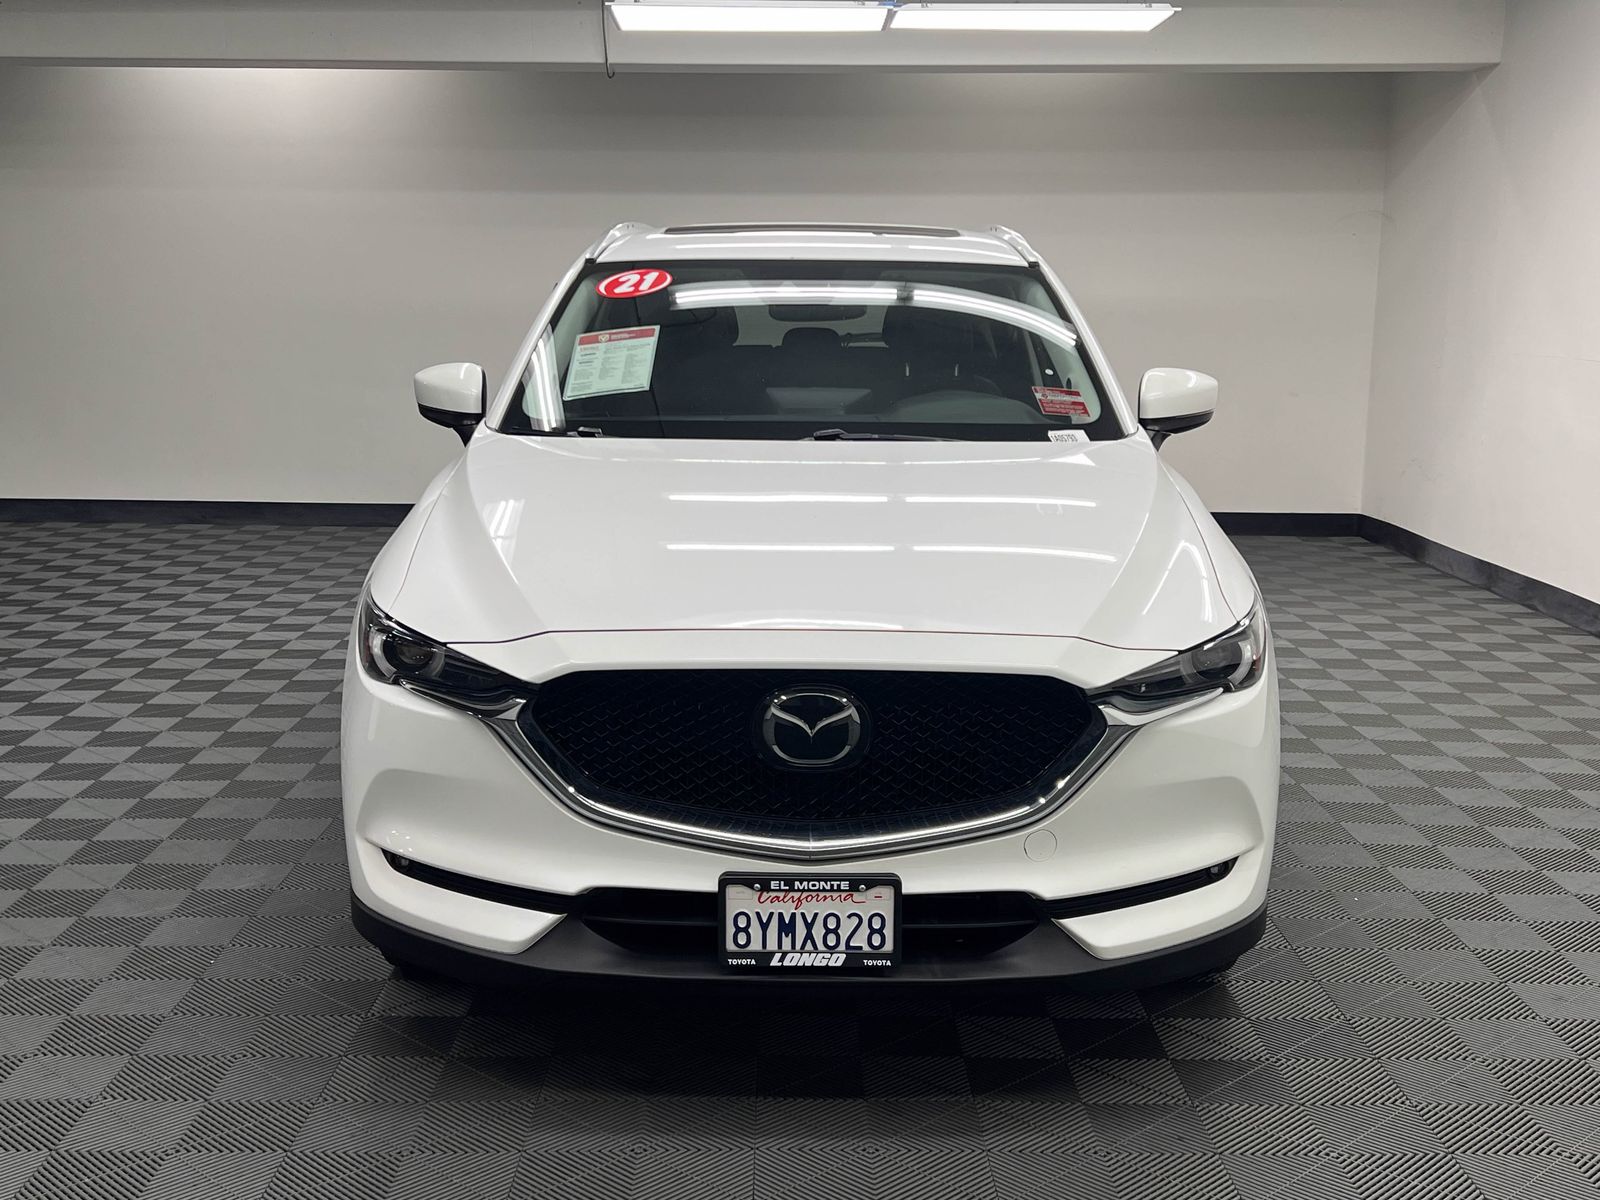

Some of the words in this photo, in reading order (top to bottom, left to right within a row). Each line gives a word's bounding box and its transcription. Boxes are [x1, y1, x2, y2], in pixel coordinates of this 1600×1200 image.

[613, 271, 660, 294] 21
[770, 880, 789, 890] EL
[794, 880, 850, 890] MONTE
[757, 890, 867, 911] California
[732, 911, 887, 951] 8YMX828
[769, 952, 847, 967] LONGO
